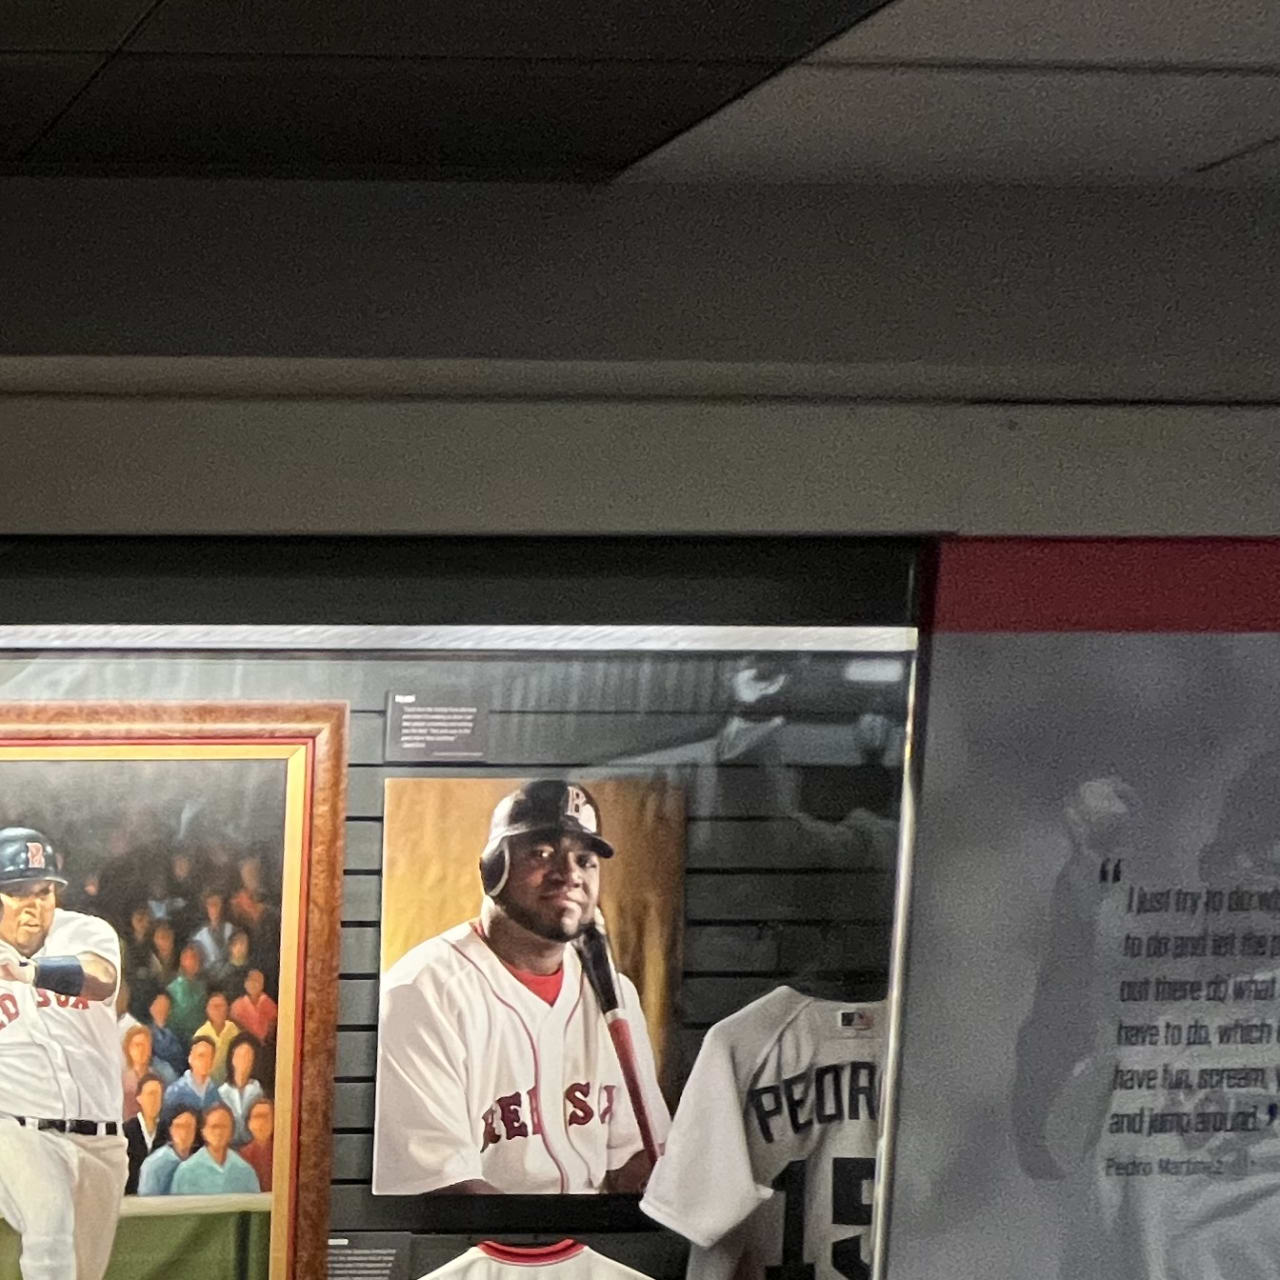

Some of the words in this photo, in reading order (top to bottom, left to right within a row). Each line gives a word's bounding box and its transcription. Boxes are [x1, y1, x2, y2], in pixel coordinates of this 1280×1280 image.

[1174, 887, 1199, 915] try
[1205, 887, 1223, 912] to
[1232, 976, 1276, 1001] what
[1116, 1020, 1160, 1046] have
[1164, 1021, 1182, 1046] to
[1217, 1020, 1272, 1045] which
[1112, 1065, 1157, 1090] have
[751, 1061, 881, 1143] PEDR
[1109, 1109, 1145, 1134] and
